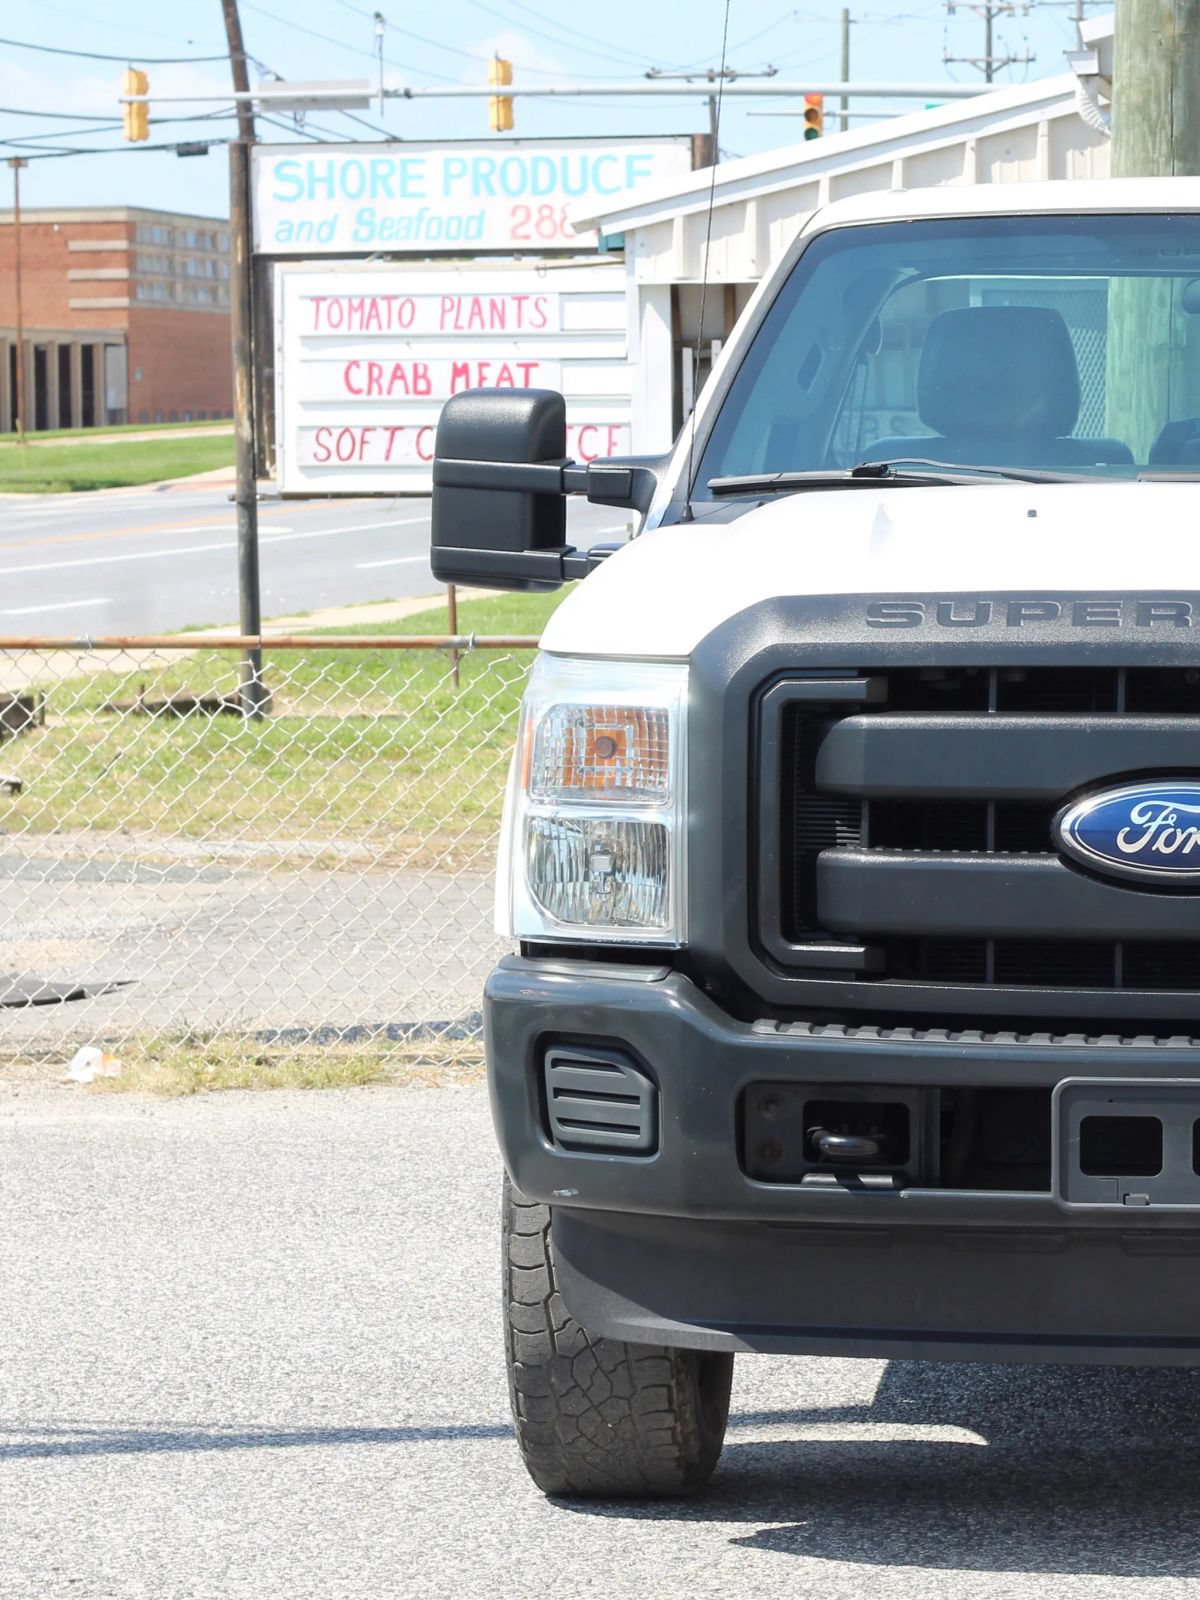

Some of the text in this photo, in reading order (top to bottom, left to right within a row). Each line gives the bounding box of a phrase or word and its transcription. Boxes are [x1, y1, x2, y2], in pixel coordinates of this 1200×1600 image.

[273, 159, 426, 203] SHORE
[276, 214, 339, 245] and
[352, 206, 486, 246] Seafood
[311, 295, 549, 332] TOMATO PLANTS
[344, 361, 541, 397] CRAB MEAT
[313, 426, 405, 463] SOFT
[866, 600, 1193, 628] SUPER
